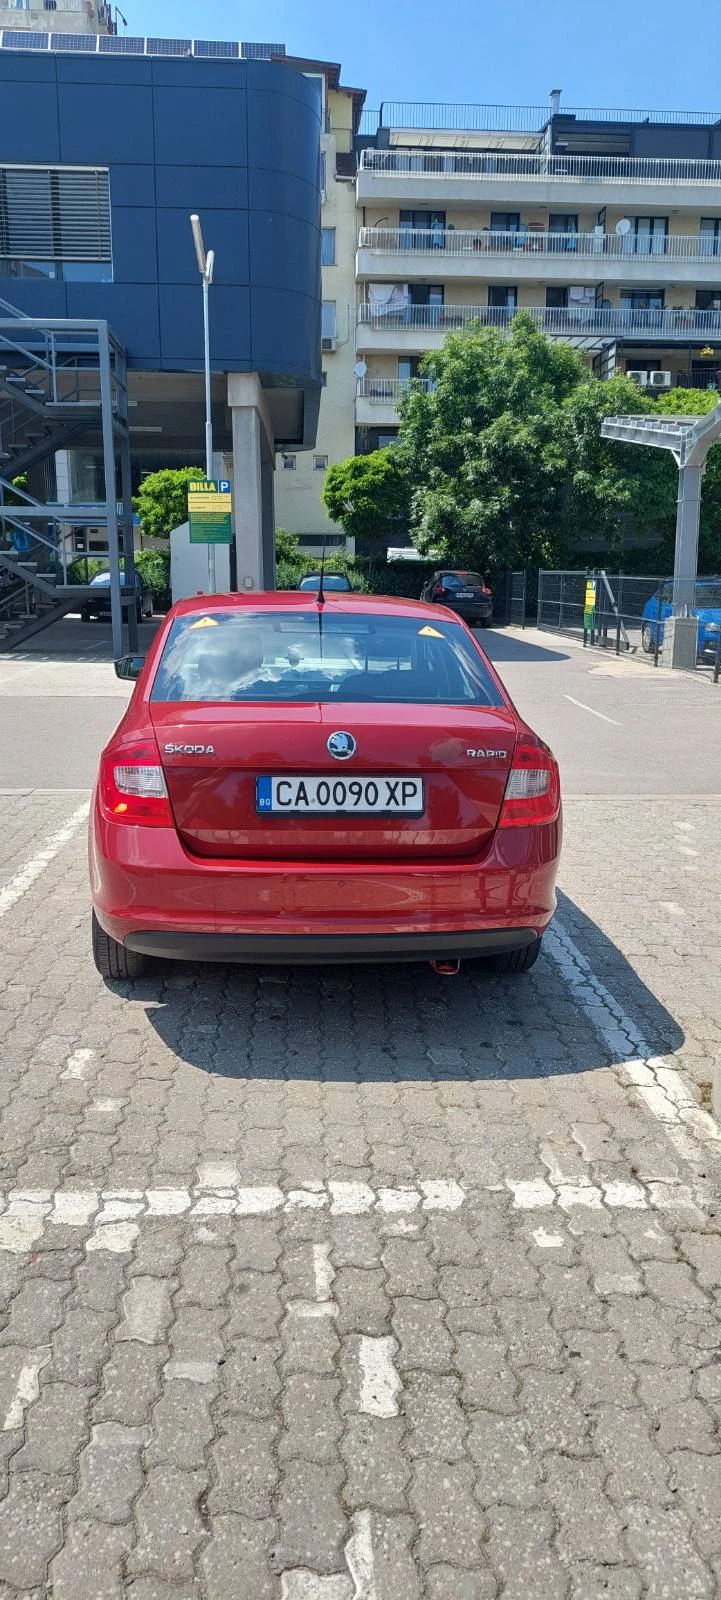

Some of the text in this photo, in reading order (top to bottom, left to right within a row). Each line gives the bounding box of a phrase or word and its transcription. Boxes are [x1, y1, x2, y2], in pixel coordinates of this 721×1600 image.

[190, 482, 229, 492] BILLA P
[466, 749, 508, 759] RAPID
[276, 780, 418, 806] CA 0090 XP
[259, 798, 271, 806] BG
